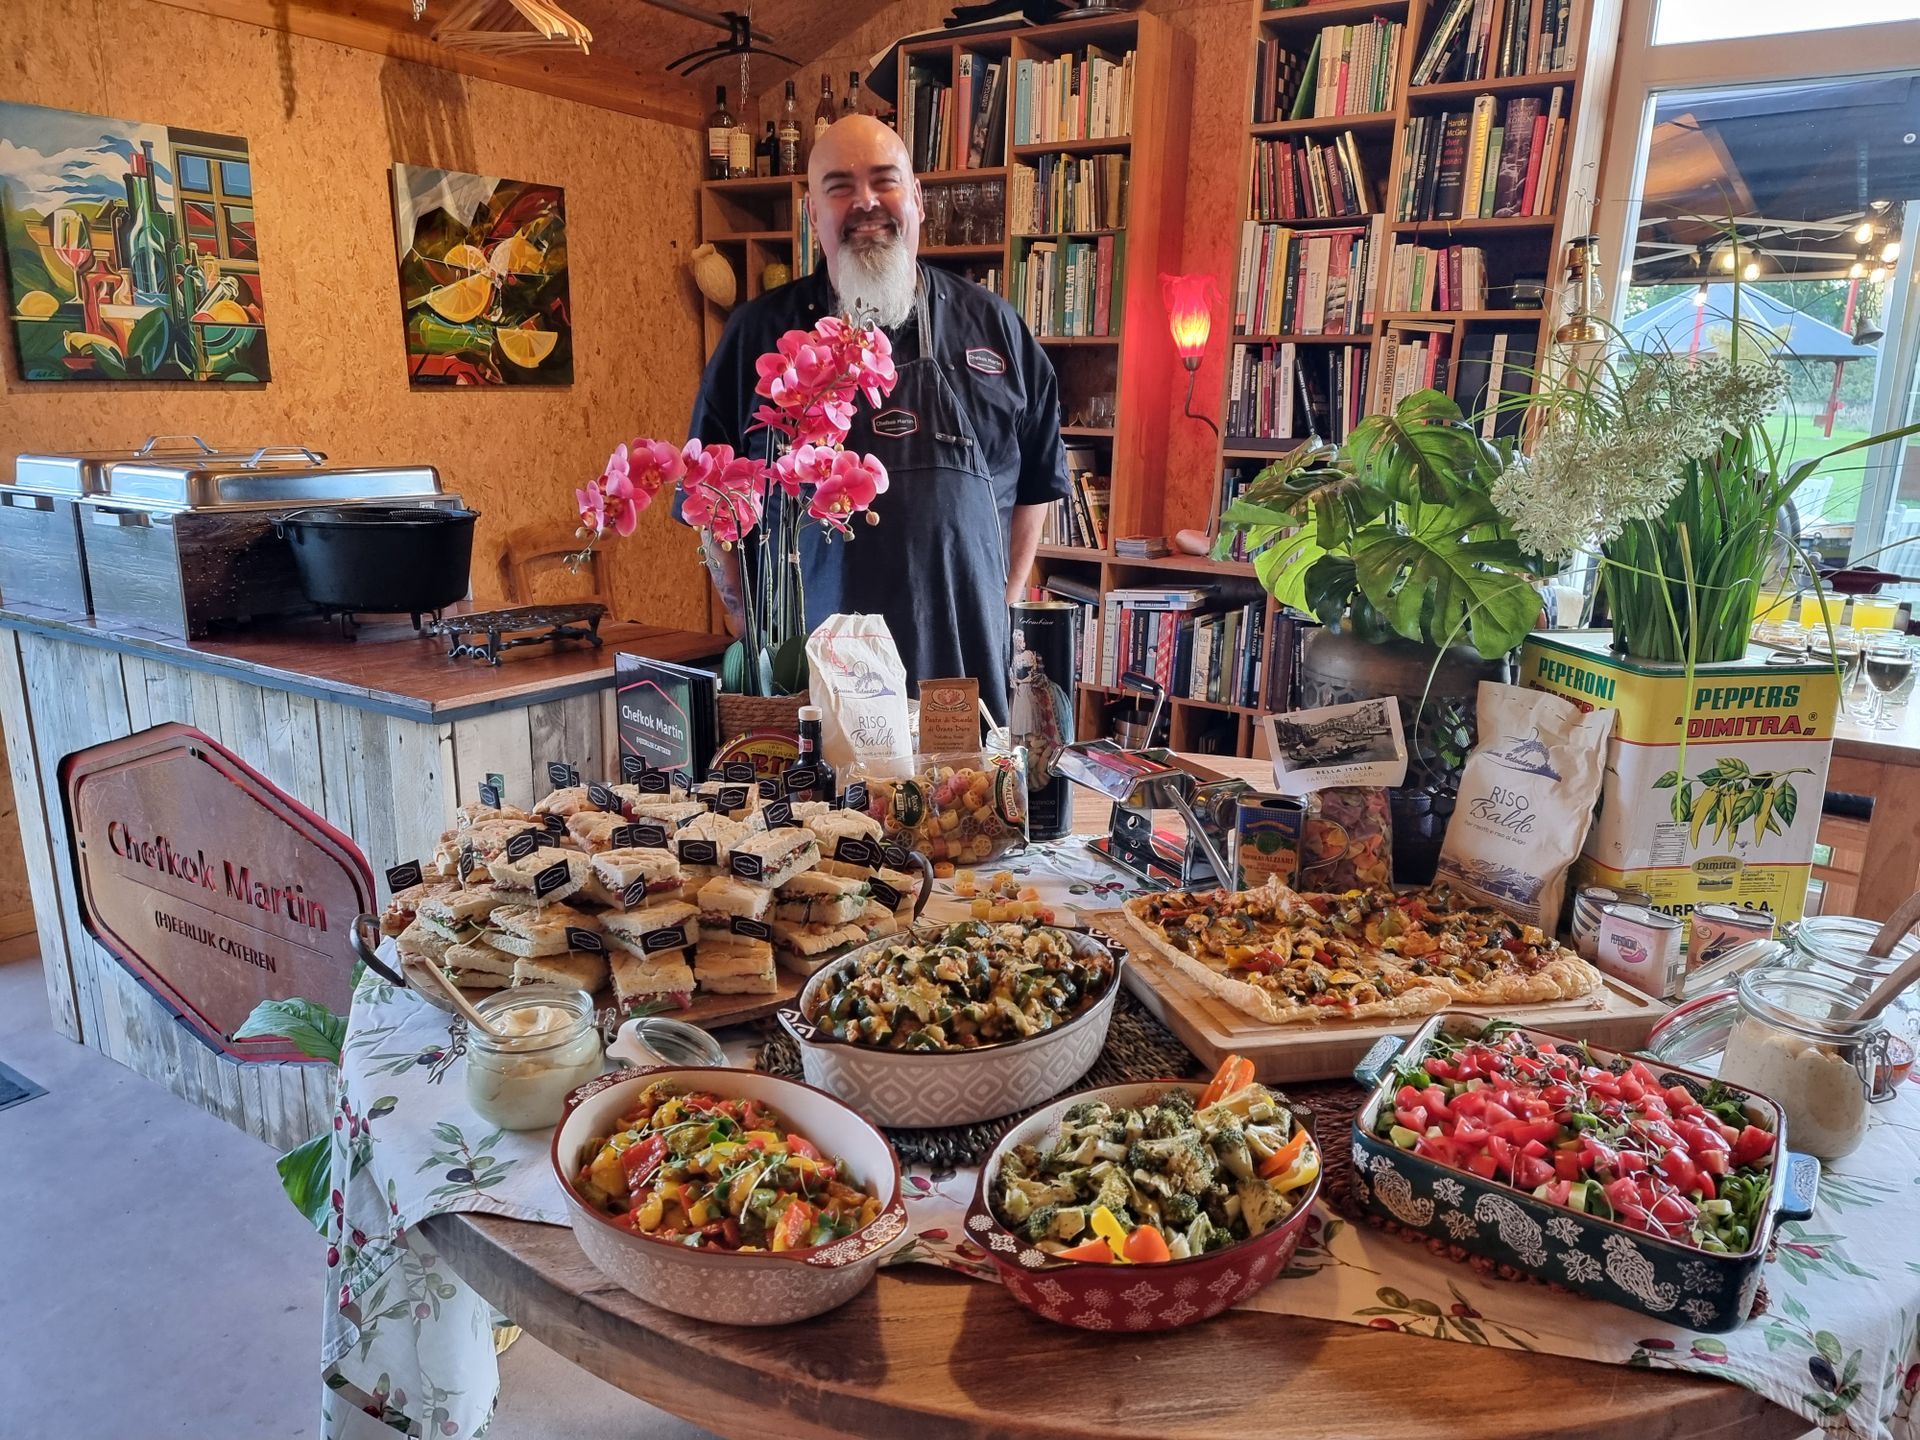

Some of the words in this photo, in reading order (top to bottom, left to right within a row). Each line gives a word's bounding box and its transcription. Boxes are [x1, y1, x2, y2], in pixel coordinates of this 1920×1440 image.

[1446, 128, 1468, 136] McGee
[1448, 118, 1468, 127] Harold
[1066, 265, 1075, 284] UW
[1064, 284, 1074, 313] TUIN
[1389, 334, 1396, 343] DE
[1382, 344, 1396, 395] OOSTERSCHELDE
[1435, 364, 1444, 384] zilt
[1538, 656, 1616, 702] PEPERONI
[1695, 685, 1800, 711] PEPPERS
[622, 705, 655, 729] Chefkok
[656, 718, 684, 740] Martin
[858, 716, 887, 730] RISO
[851, 728, 896, 750] Baldo
[1490, 786, 1529, 810] RISO
[1470, 798, 1536, 834] Baldo
[106, 820, 217, 893] Chefkok
[222, 860, 328, 932] Martin
[1696, 860, 1737, 872] Dimitra
[154, 909, 217, 950] (H)EERLIJK
[218, 935, 277, 974] CATEREN
